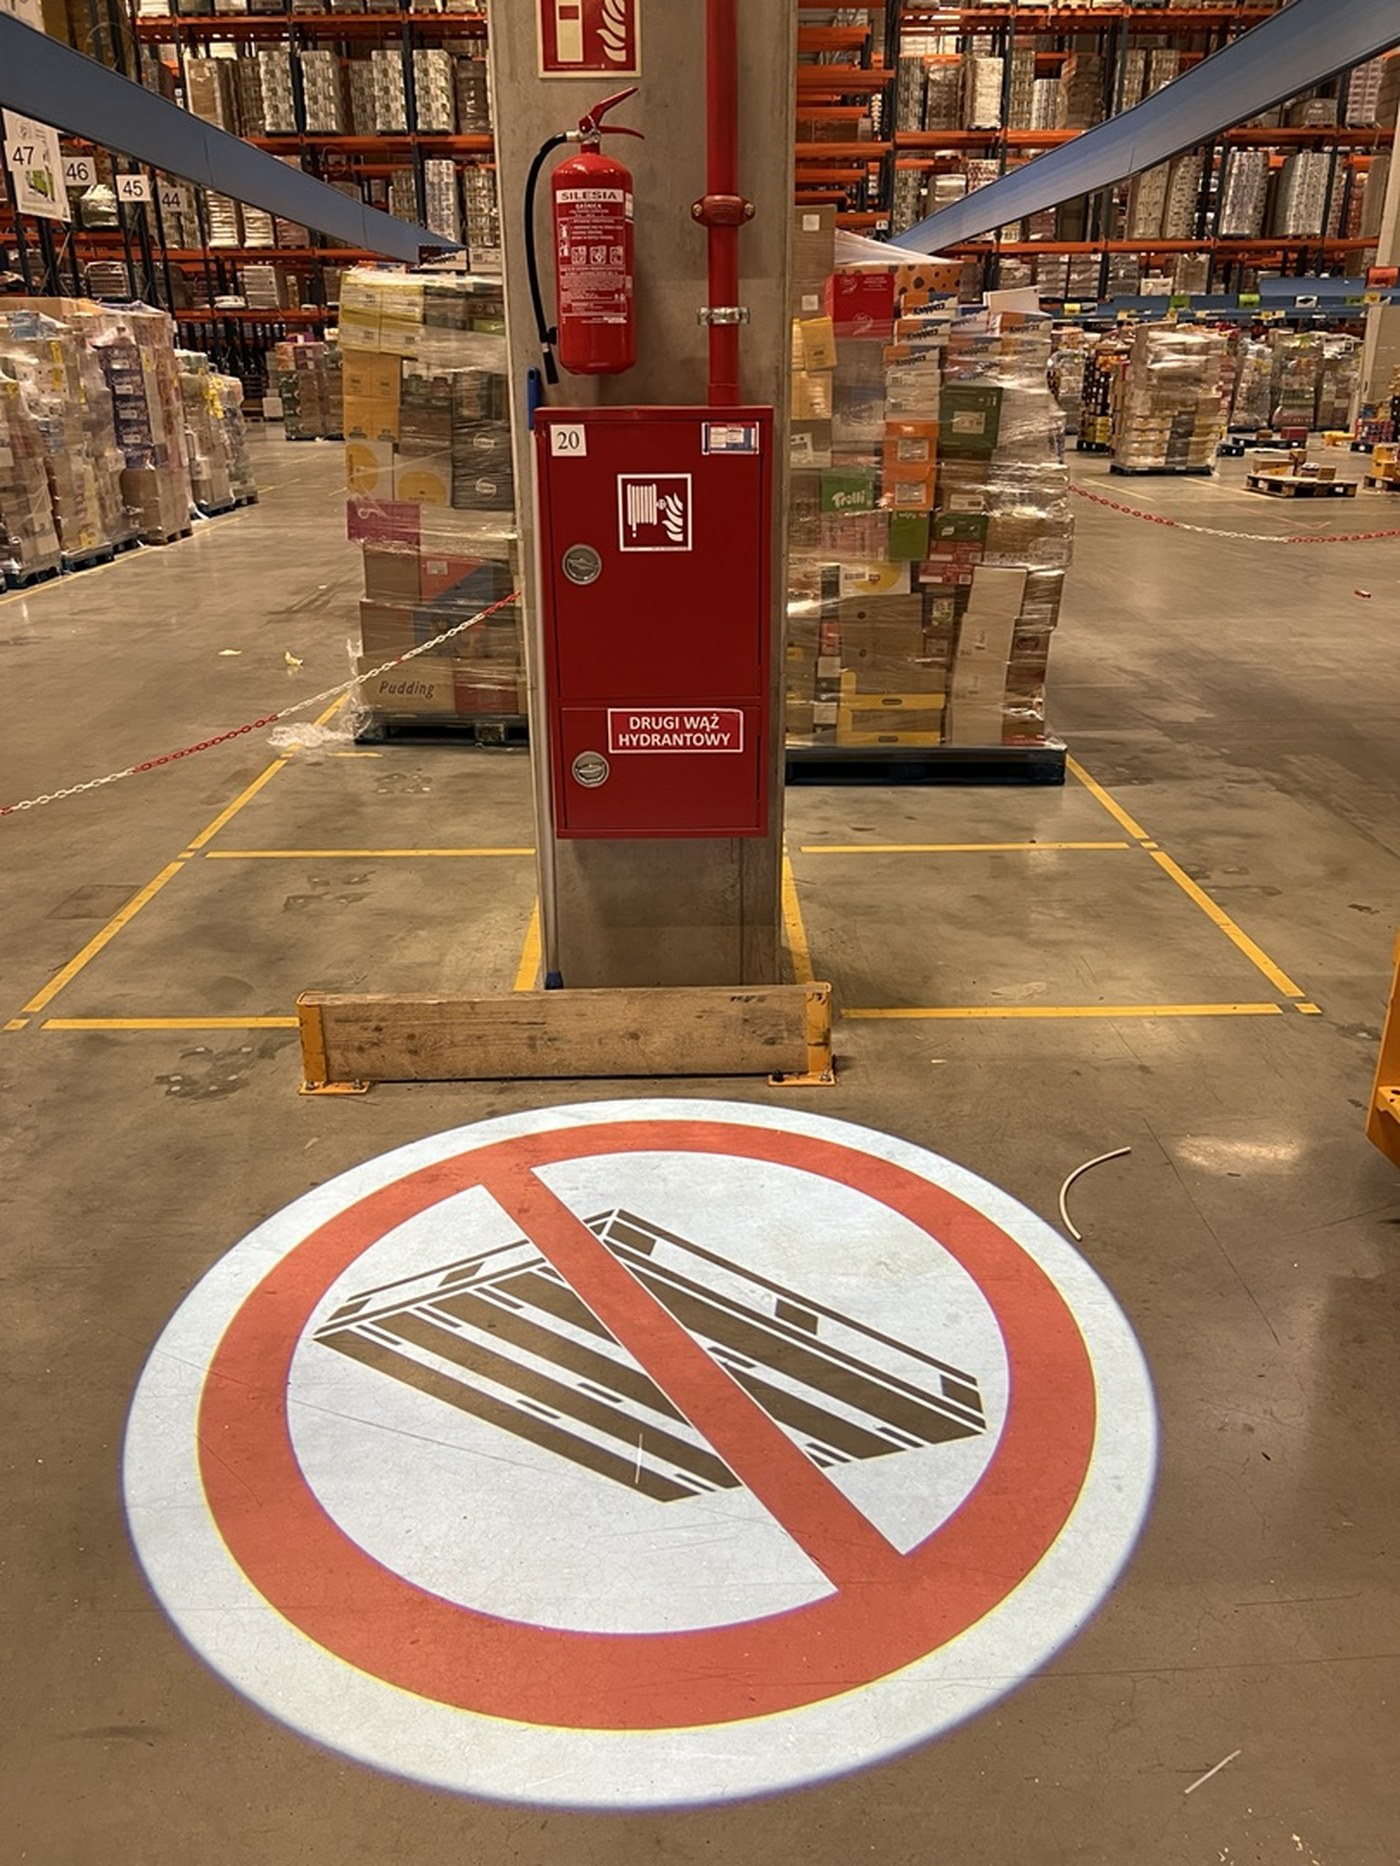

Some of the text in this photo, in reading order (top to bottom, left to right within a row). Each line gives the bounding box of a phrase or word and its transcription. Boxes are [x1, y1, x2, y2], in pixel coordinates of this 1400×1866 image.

[12, 146, 35, 166] 47
[66, 163, 89, 181] 46
[122, 182, 144, 197] 45
[561, 190, 617, 200] SILESIA
[161, 192, 181, 207] 44
[557, 431, 580, 450] 20
[831, 490, 866, 508] Trolli
[379, 680, 436, 699] Pudding
[629, 713, 720, 733] DRUGI WĄŻ
[618, 731, 731, 748] HYDRANTOWY
